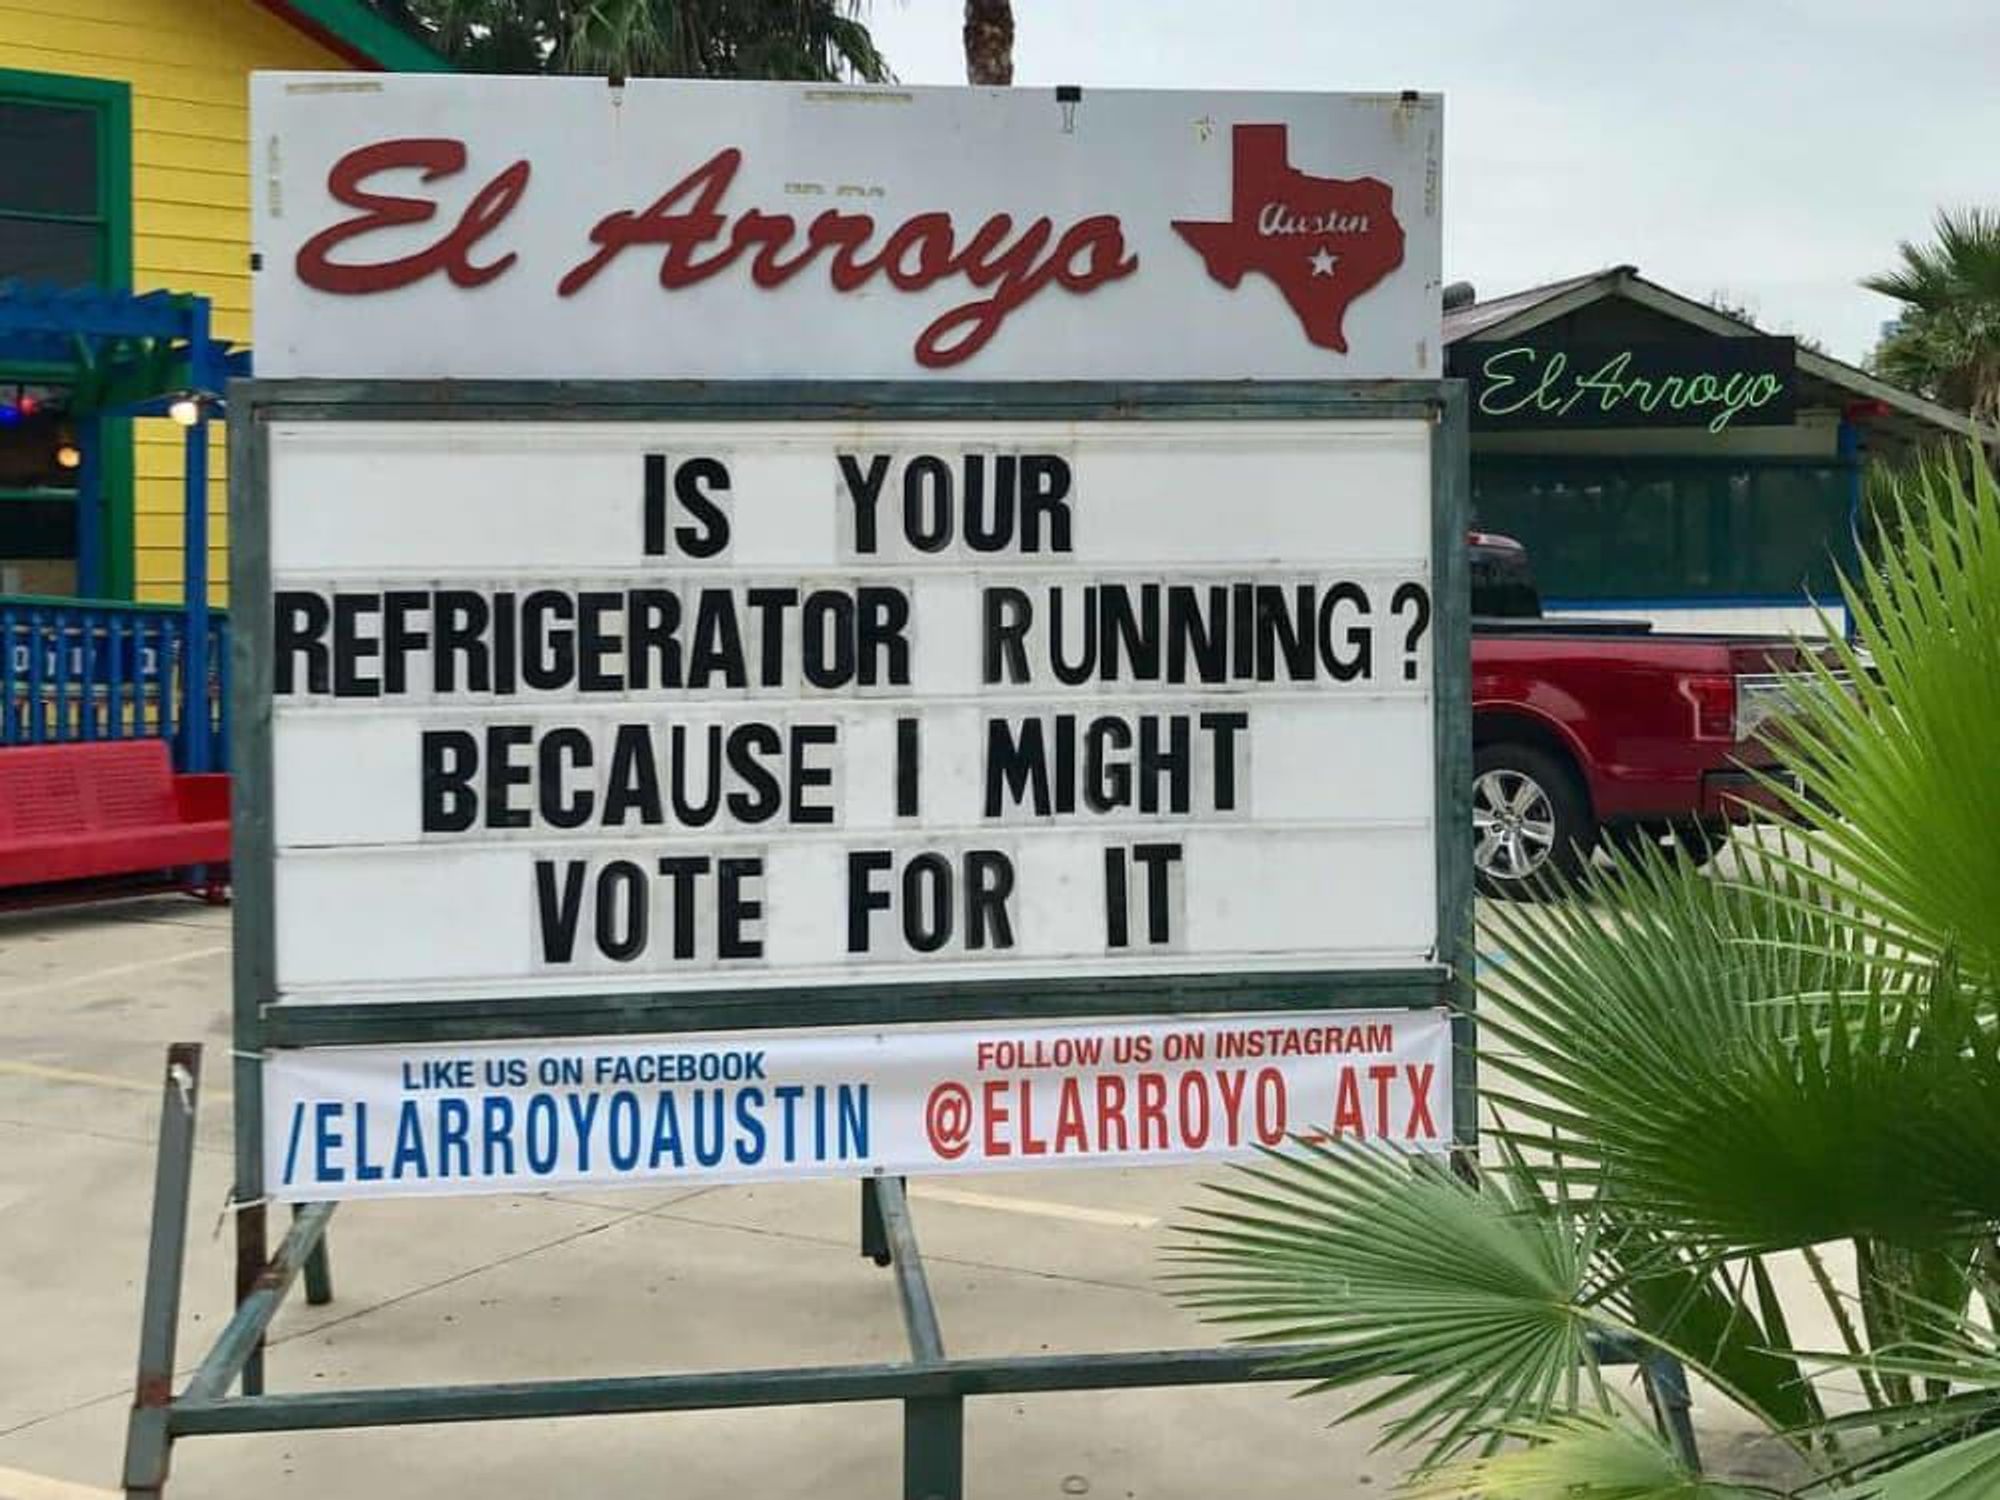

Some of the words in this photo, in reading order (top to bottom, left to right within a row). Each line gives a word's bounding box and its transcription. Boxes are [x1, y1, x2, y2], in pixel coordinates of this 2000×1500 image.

[296, 138, 532, 296] El
[557, 147, 1139, 368] Arroyo
[1258, 202, 1369, 236] Austin
[1479, 348, 1567, 414] El
[1557, 352, 1784, 434] Arroyo
[644, 453, 731, 559] IS
[836, 453, 1073, 554] YOUR
[273, 586, 911, 698] REFRIGERATOR
[421, 722, 838, 833] BECAUSE
[897, 717, 919, 817] I
[984, 712, 1249, 817] MIGHT
[535, 855, 764, 963] VOTE
[846, 849, 1016, 953] FOR
[1104, 843, 1183, 947] IT
[402, 1059, 475, 1091] LIKE
[485, 1057, 528, 1088] US
[538, 1055, 584, 1086] ON
[594, 1050, 767, 1084] FACEBOOK
[976, 1037, 1101, 1071] FOLLOW
[1114, 1034, 1152, 1064] US
[1163, 1031, 1205, 1061] ON
[1215, 1024, 1393, 1059] INSTAGRAM
[282, 1082, 872, 1185] /ELARROYOAUSTIN
